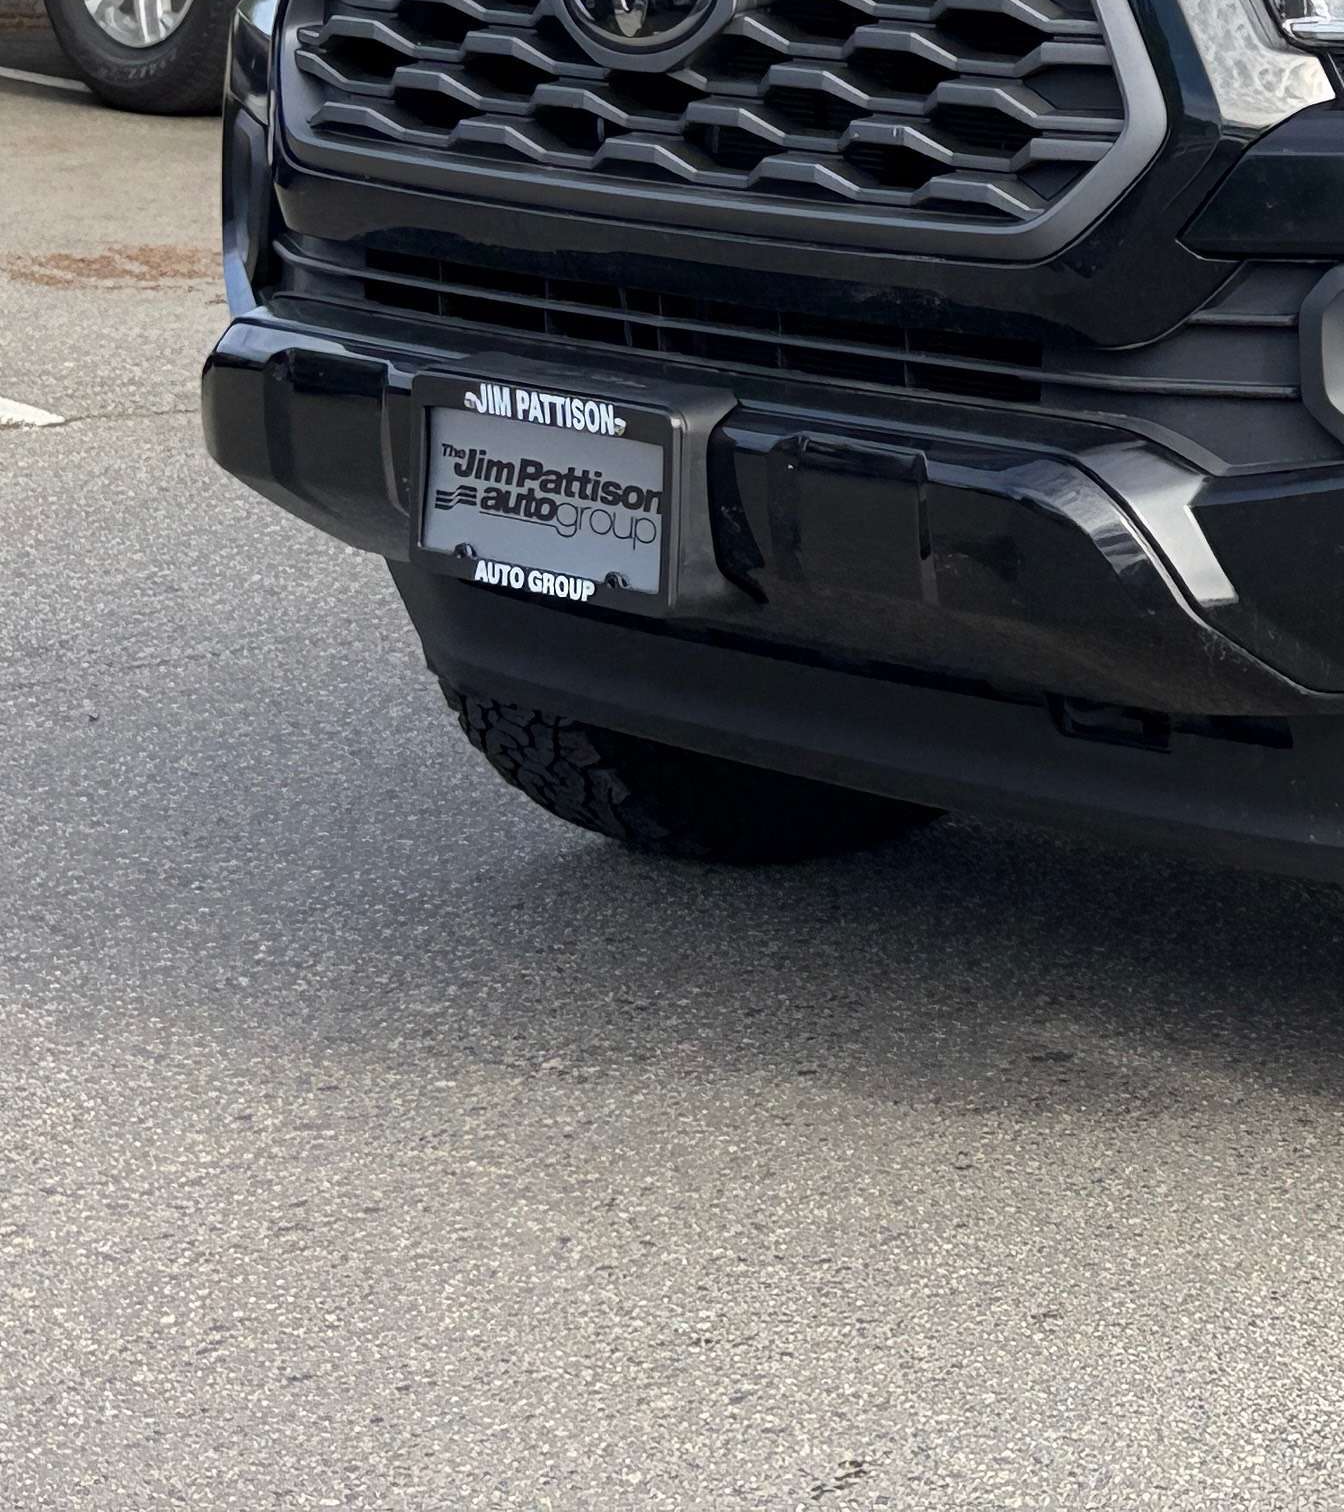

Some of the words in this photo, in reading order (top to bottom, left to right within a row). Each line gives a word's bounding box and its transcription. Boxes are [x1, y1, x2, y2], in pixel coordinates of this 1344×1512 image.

[475, 383, 512, 417] JIM
[515, 390, 616, 436] PATTISON
[441, 443, 466, 459] The
[474, 560, 525, 589] AUTO
[528, 570, 595, 602] GROUP
